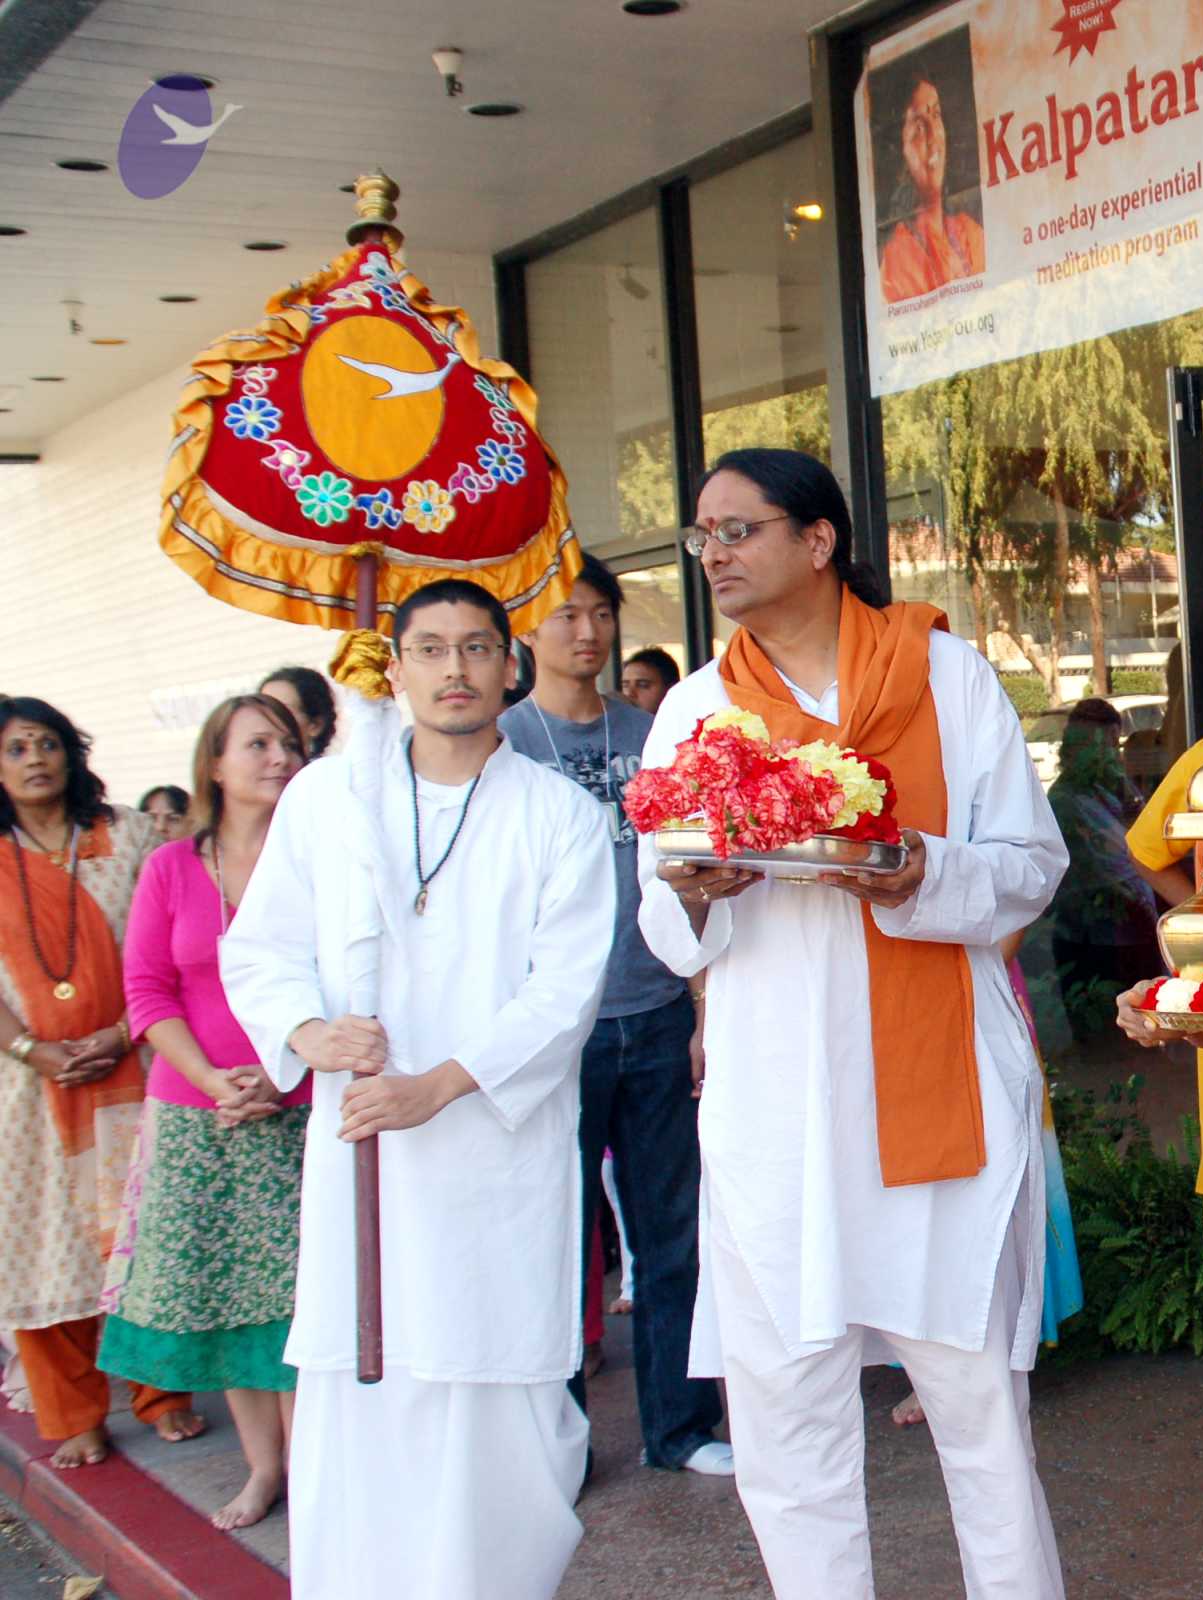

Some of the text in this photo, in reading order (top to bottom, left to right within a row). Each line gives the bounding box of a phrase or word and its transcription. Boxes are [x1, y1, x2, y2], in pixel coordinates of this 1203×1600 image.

[1023, 161, 1203, 245] a one-day experiential
[1037, 219, 1200, 285] meditation program
